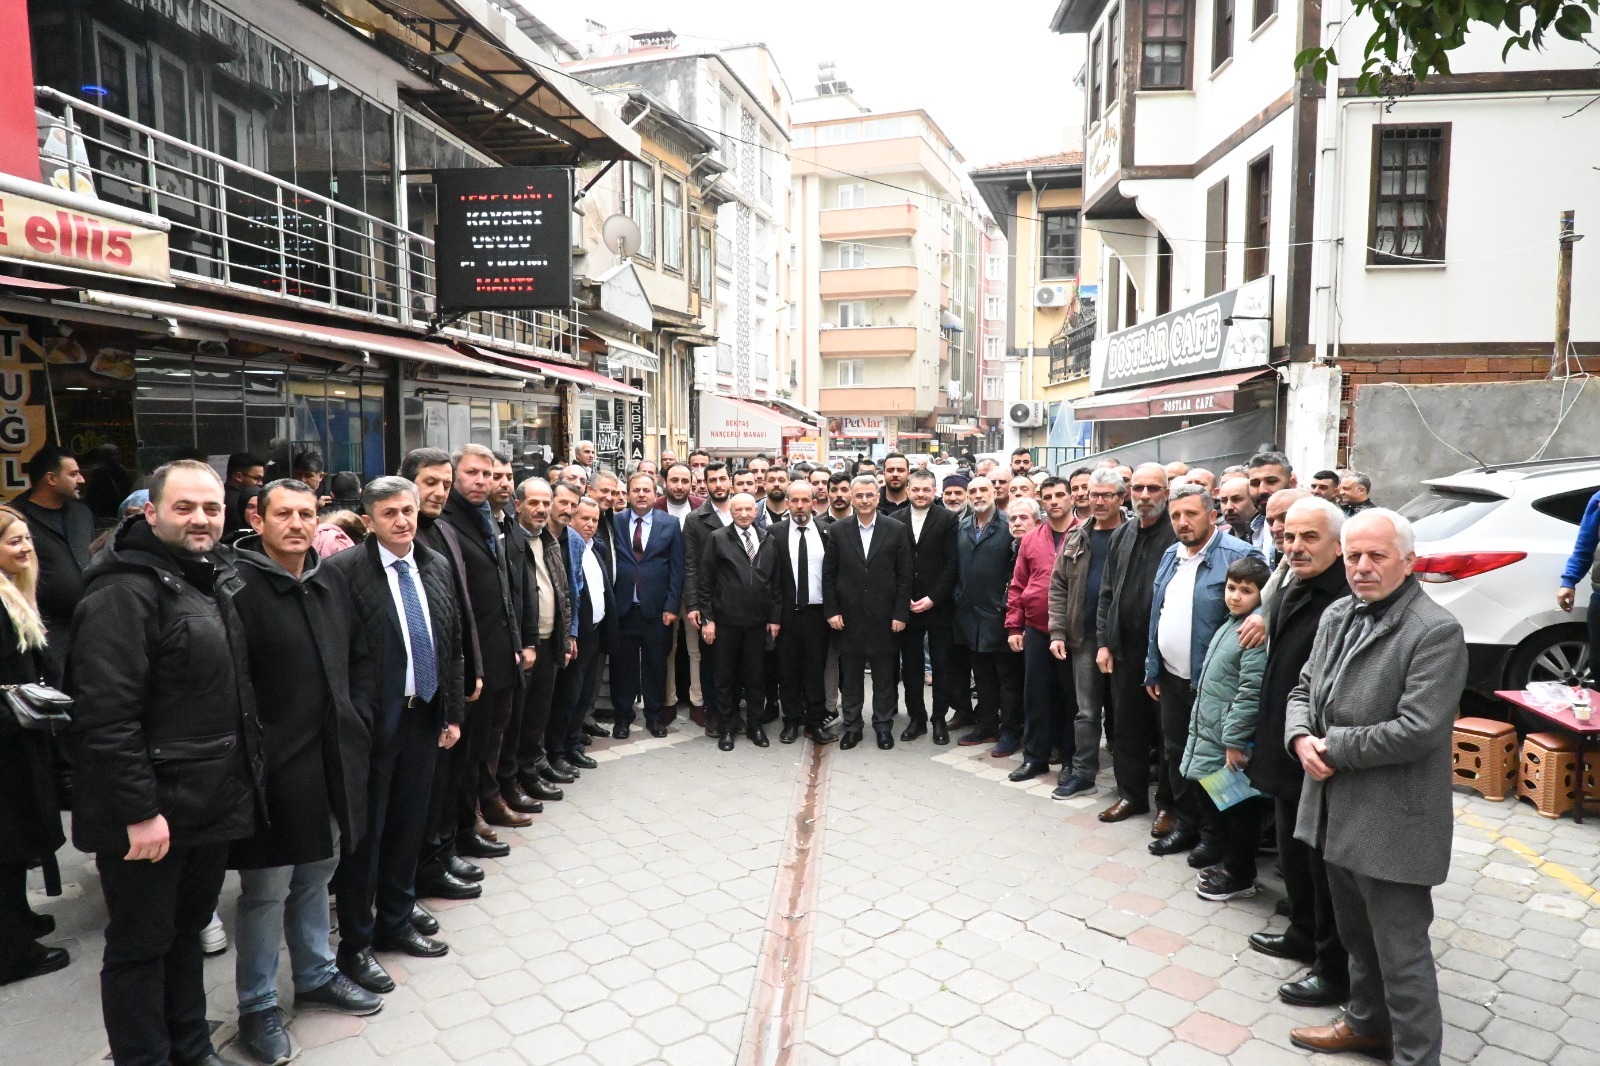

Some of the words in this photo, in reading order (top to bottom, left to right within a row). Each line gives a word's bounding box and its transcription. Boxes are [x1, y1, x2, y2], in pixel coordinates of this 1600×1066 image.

[25, 210, 133, 267] elli5
[1108, 322, 1169, 379] DOSTLAR
[1171, 303, 1221, 366] CAFE
[1163, 398, 1191, 412] DOSTLAR
[1195, 396, 1214, 410] CAFE
[725, 420, 750, 429] BEKTAŞ
[844, 417, 882, 428] PetMar
[710, 430, 741, 439] HANÇERLİ
